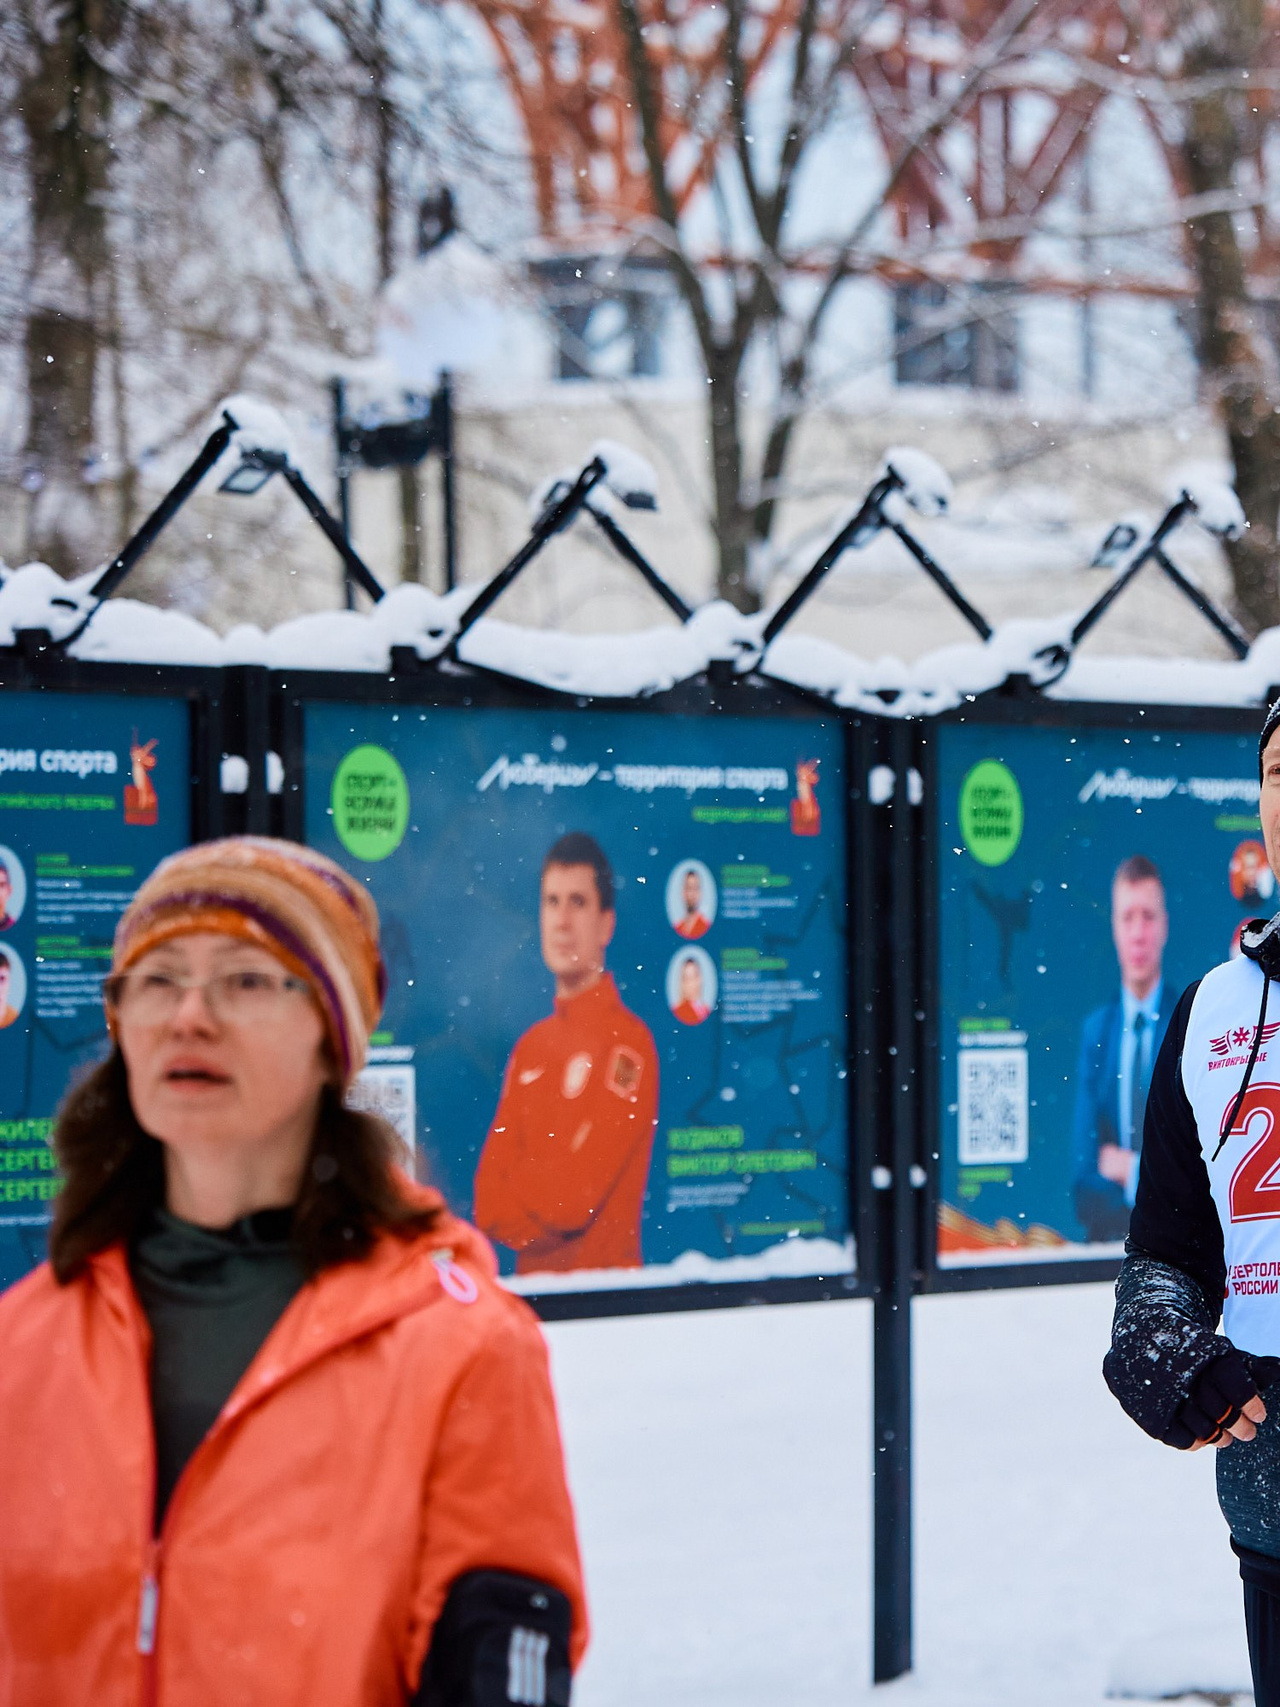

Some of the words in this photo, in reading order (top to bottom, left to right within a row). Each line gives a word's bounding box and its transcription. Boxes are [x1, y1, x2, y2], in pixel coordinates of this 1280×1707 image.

[40, 749, 117, 778] спорта
[1207, 1051, 1268, 1072] ВИНТОКРЫЫЕ
[1232, 1280, 1278, 1296] РОССИИ
